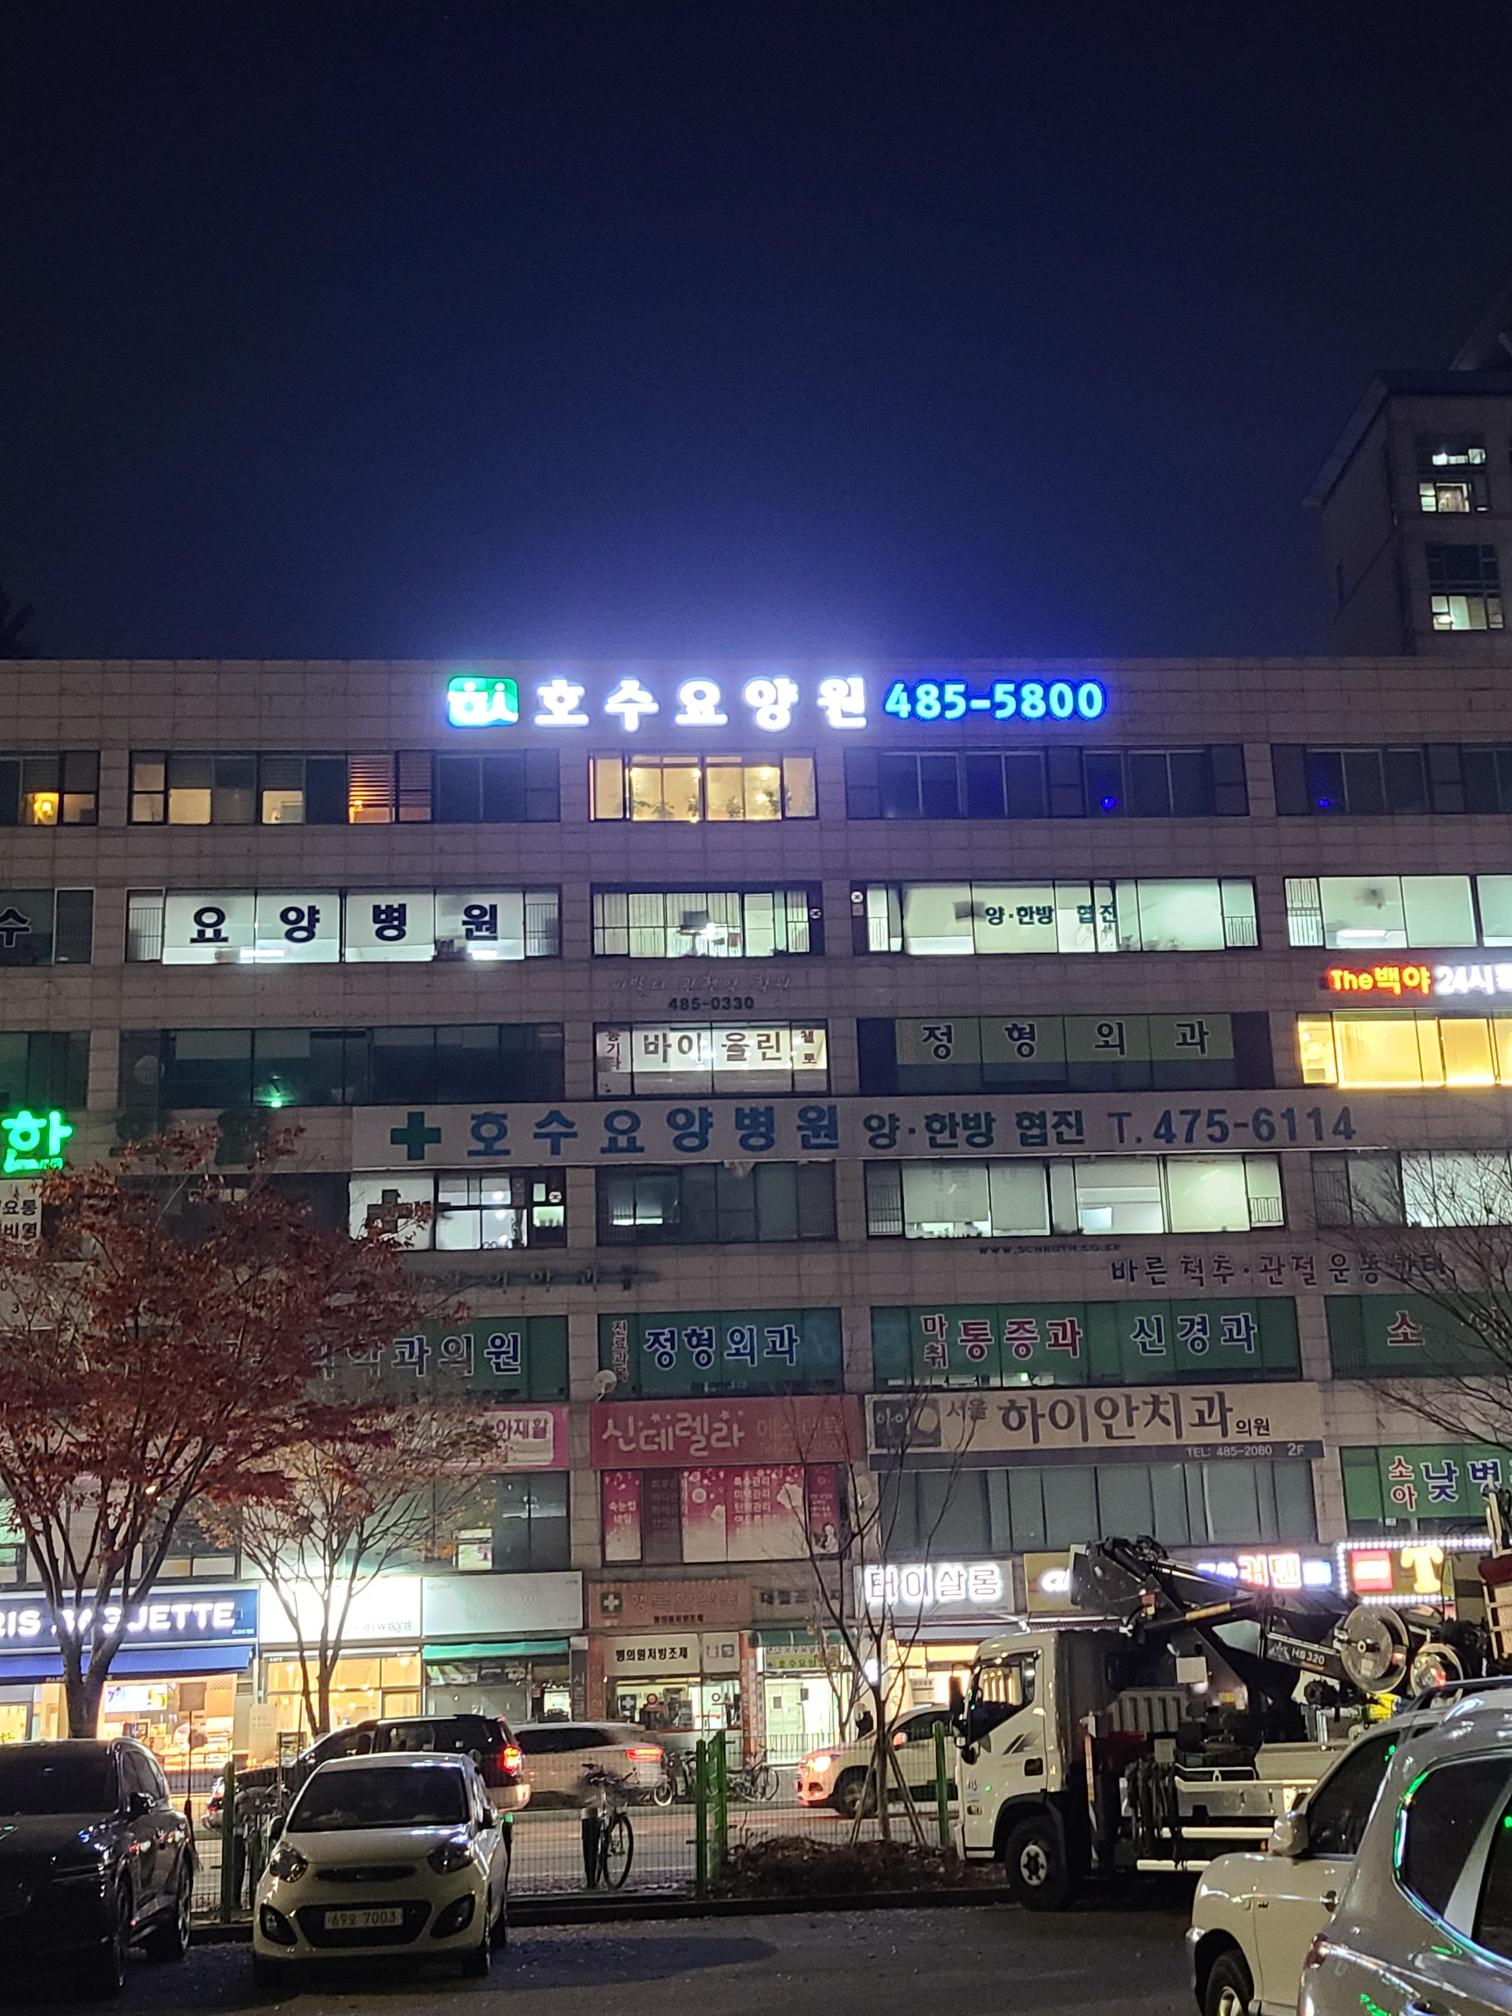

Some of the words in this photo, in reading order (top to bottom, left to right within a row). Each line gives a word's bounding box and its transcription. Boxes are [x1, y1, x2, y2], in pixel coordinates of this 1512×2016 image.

[534, 675, 869, 732] 호수요양원
[884, 680, 1104, 721] 485-5800
[985, 904, 1055, 926] 양·한방
[668, 996, 754, 1011] 485-0330
[642, 1031, 782, 1064] 바이올린
[1, 1109, 74, 1173] 한
[466, 1103, 841, 1158] 호수요양병원
[862, 1110, 997, 1150] 양·한방
[1015, 1109, 1085, 1148] 협진
[1152, 1105, 1357, 1145] 475-6114
[1110, 1254, 1169, 1287] 바른
[1180, 1252, 1319, 1289] 척추·관절
[644, 1324, 800, 1370] 정형외과
[956, 1317, 1083, 1362] 통증과
[1130, 1312, 1258, 1358] 신경과
[600, 1410, 746, 1458] 신데렐라
[1235, 1416, 1271, 1438] 의원
[1216, 1445, 1273, 1458] 485-2080
[363, 1910, 397, 1926] 7003
